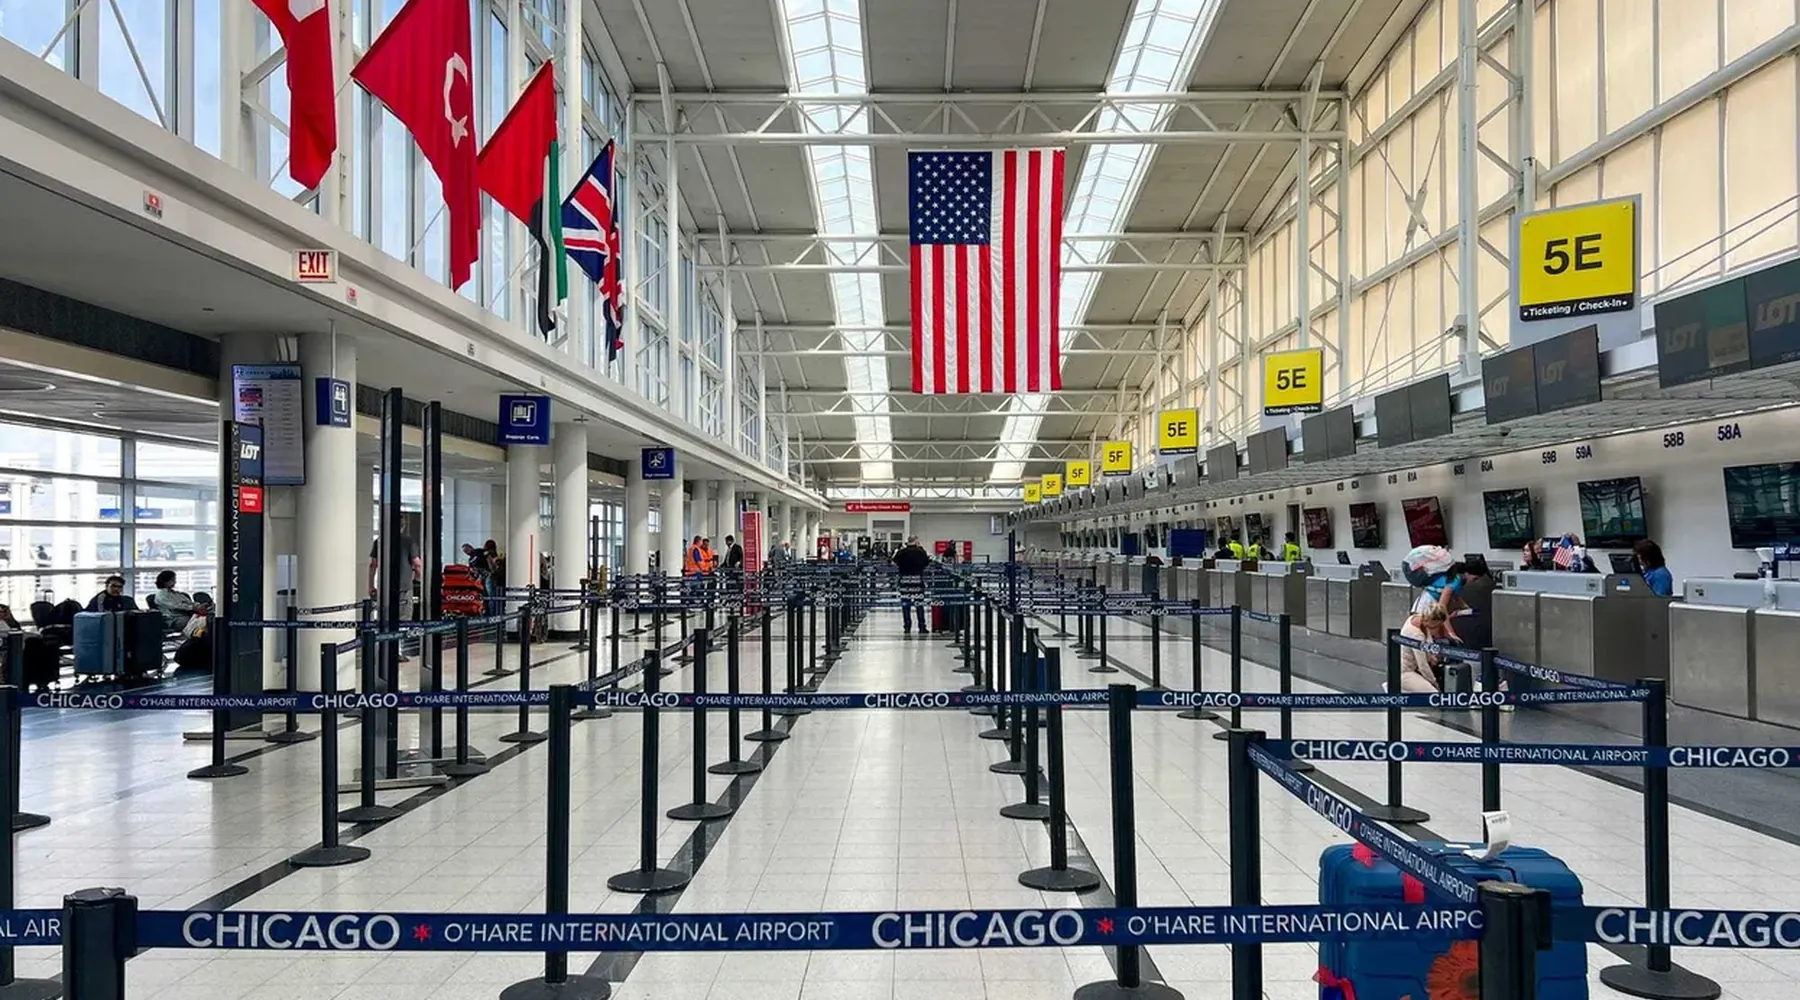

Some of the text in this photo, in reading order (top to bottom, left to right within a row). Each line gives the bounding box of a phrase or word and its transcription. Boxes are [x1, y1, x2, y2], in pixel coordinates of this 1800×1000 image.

[299, 251, 329, 273] EXIT
[1544, 233, 1603, 275] 5E
[1529, 304, 1571, 317] Ticketing
[1578, 299, 1622, 312] Check-In
[1276, 367, 1307, 391] 5E
[1167, 421, 1188, 438] 5E
[1717, 423, 1742, 441] 58A
[1663, 431, 1685, 448] 58B
[240, 443, 259, 460] LOT
[1108, 450, 1124, 463] 5F
[1542, 450, 1558, 465] 59B
[1575, 445, 1593, 460] 59A
[1071, 468, 1084, 478] 5F
[1046, 480, 1057, 489] 5F
[231, 487, 239, 561] ALLIANCE
[1529, 665, 1560, 683] CHICAGO
[37, 693, 123, 709] CHICAGO
[140, 698, 176, 706] O'HARE
[179, 698, 254, 707] INTERNATIONAL
[257, 698, 298, 707] AIRPORT
[312, 693, 398, 709] CHICAGO
[414, 695, 451, 704] O'HARE
[452, 694, 528, 703] INTERNATIONAL
[594, 691, 680, 707] CHICAGO
[695, 696, 732, 705] O'HARE
[734, 696, 808, 705] INTERNATIONAL
[811, 696, 851, 705] AIRPORT
[864, 693, 949, 708] CHICAGO
[966, 695, 1002, 703] O'HARE
[1004, 693, 1078, 703] INTERNATIONAL
[1161, 692, 1241, 707] CHICAGO
[1257, 696, 1292, 705] O'HARE
[1295, 696, 1368, 705] INTERNATIONAL
[1370, 696, 1409, 705] AIRPORT
[1429, 692, 1505, 707] CHICAGO
[1521, 692, 1555, 702] O'HARE
[1557, 690, 1628, 701] INTERNATIONAL
[1290, 740, 1789, 767] CHICAGO O'HARE INTERNATIONAL AIRPORT CHICAGO
[1307, 784, 1352, 832] CHICAGO
[1359, 822, 1383, 849] O'HARE
[1383, 835, 1438, 885] INTERNATIONAL
[1437, 870, 1475, 903] AIRPORT
[182, 912, 401, 949] CHICAGO
[443, 923, 533, 943] O'HARE
[541, 922, 729, 943] INTERNATIONAL
[736, 920, 834, 941] AIRPORT
[871, 910, 1085, 946] CHICAGO
[1127, 916, 1216, 936] O'HARE
[1224, 912, 1409, 935] INTERNATIONAL
[1594, 908, 1800, 949] CHICAGO
